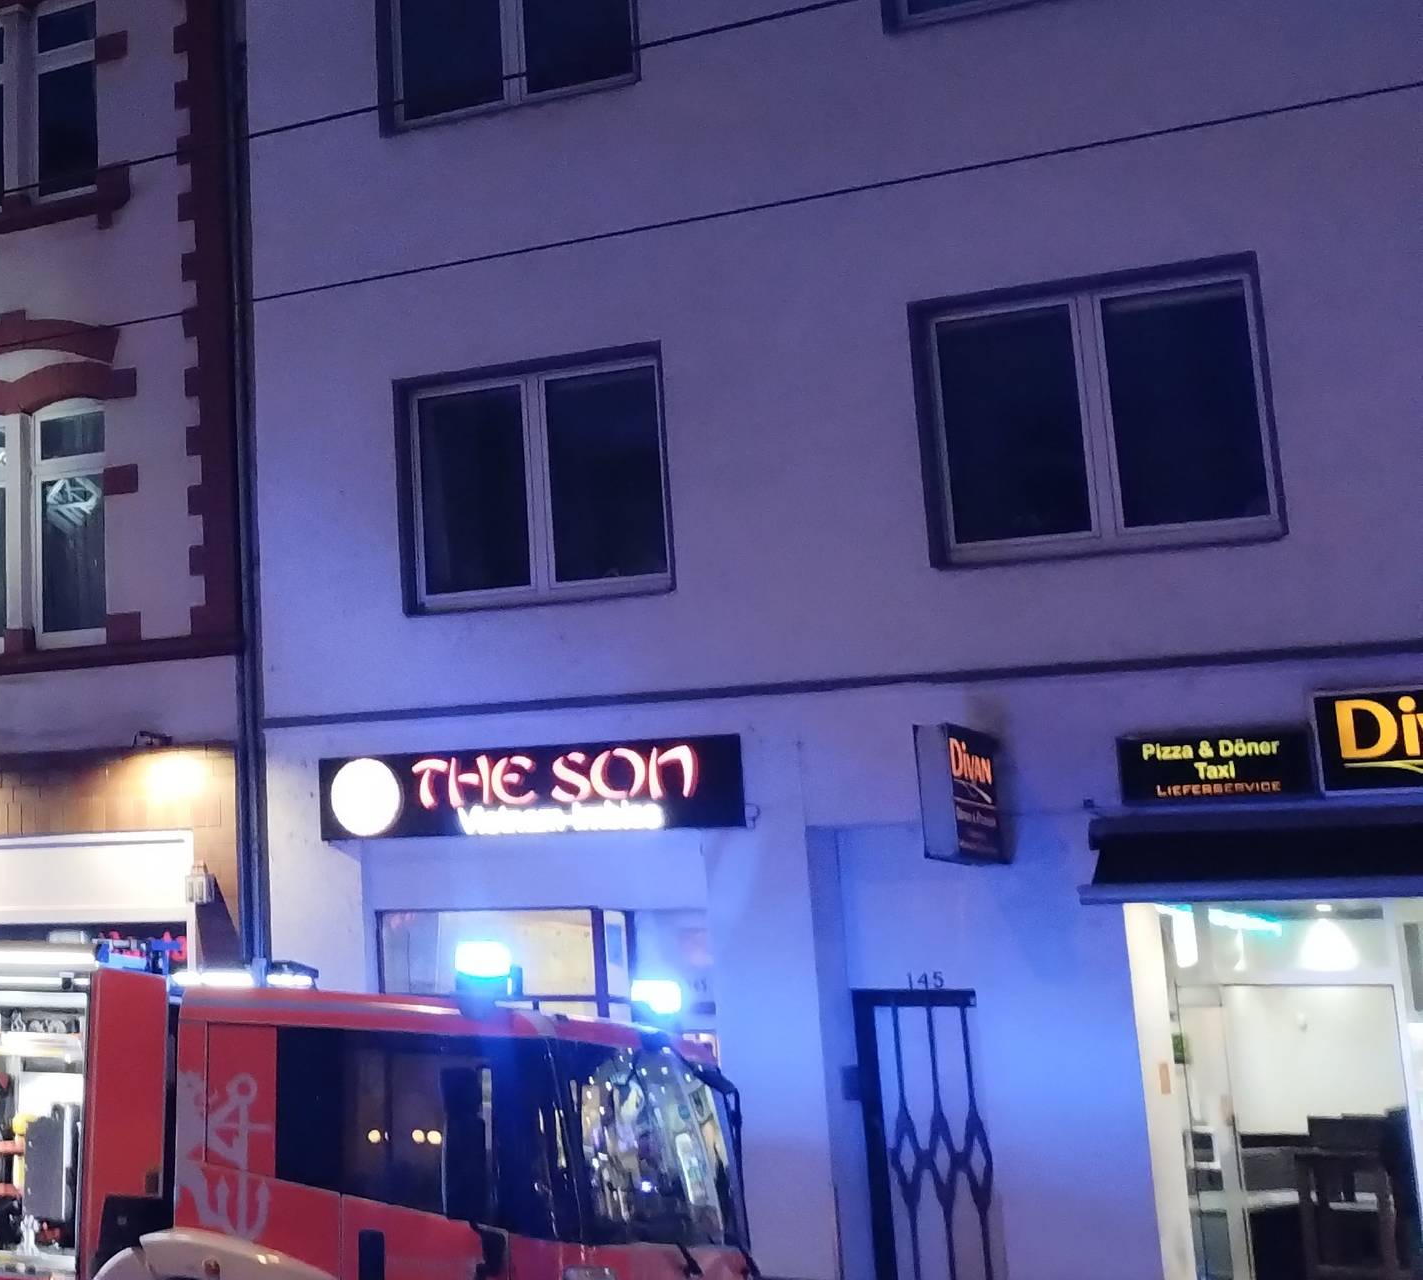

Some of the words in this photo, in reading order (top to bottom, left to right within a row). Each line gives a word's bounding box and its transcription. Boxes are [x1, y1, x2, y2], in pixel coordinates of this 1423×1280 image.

[1335, 696, 1423, 759] Di
[1141, 742, 1194, 761] Pizza
[1198, 740, 1215, 758] &
[1218, 738, 1280, 758] Döner
[411, 754, 538, 809] THE
[551, 744, 697, 801] SON
[1194, 760, 1236, 780] Taxi
[1155, 781, 1282, 798] LIEFERSERVICE
[906, 970, 944, 990] 145
